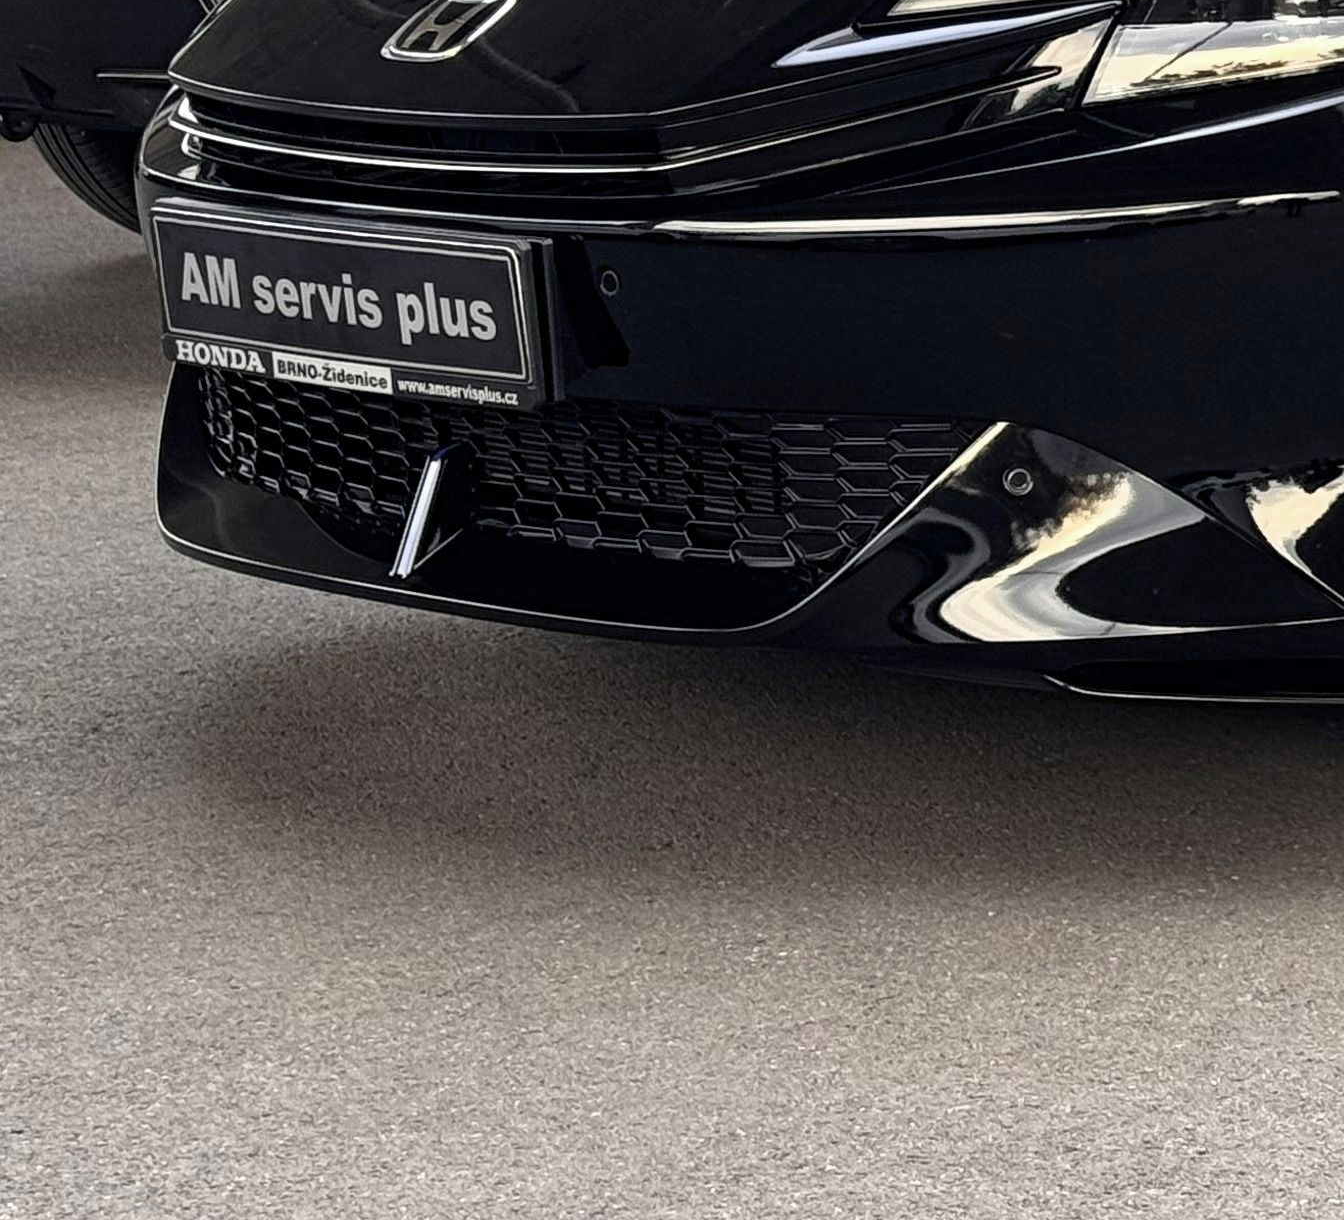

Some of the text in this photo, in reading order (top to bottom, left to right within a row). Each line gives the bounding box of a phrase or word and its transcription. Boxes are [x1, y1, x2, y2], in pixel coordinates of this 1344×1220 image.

[181, 251, 498, 346] AM servis plus
[175, 339, 267, 374] HONDA
[396, 379, 520, 406] www.amservisplus.cz
